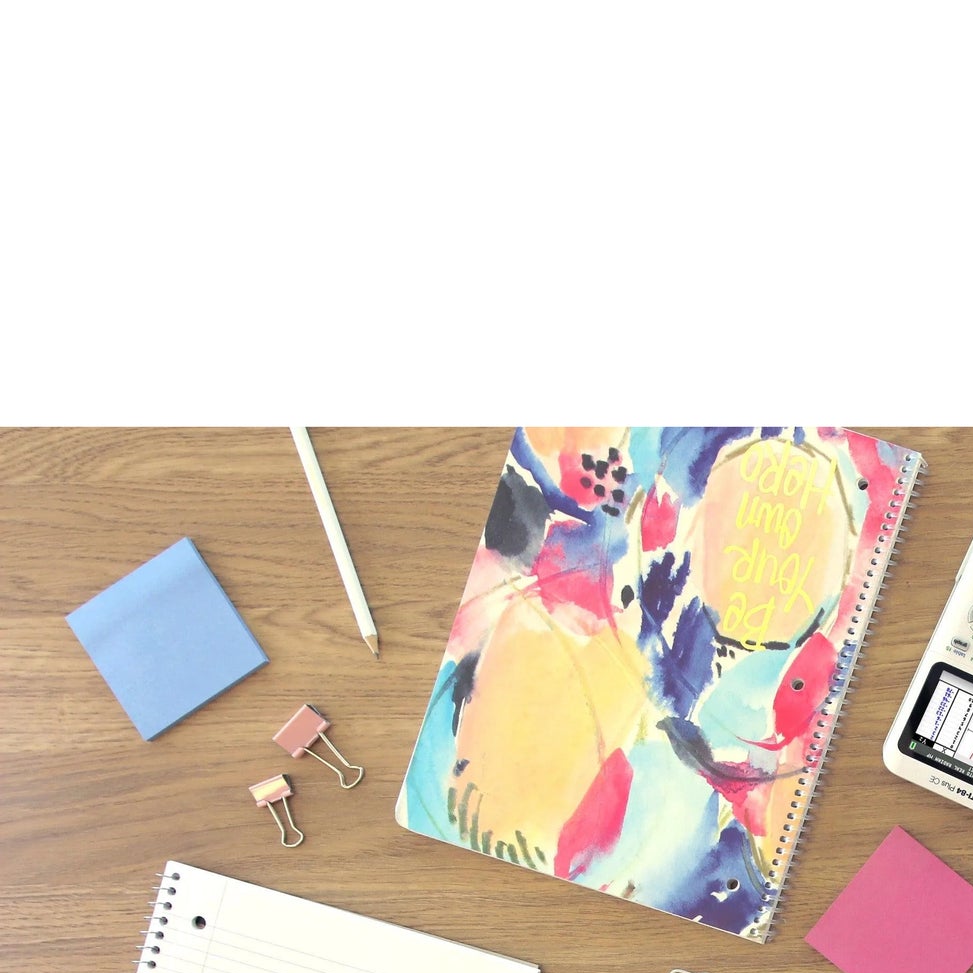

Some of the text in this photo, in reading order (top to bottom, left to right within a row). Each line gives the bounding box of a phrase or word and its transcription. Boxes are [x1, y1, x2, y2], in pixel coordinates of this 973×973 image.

[739, 439, 837, 516] Hero
[722, 537, 815, 616] Your
[723, 592, 777, 652] Be
[929, 775, 940, 785] CE
[941, 780, 956, 792] Plus
